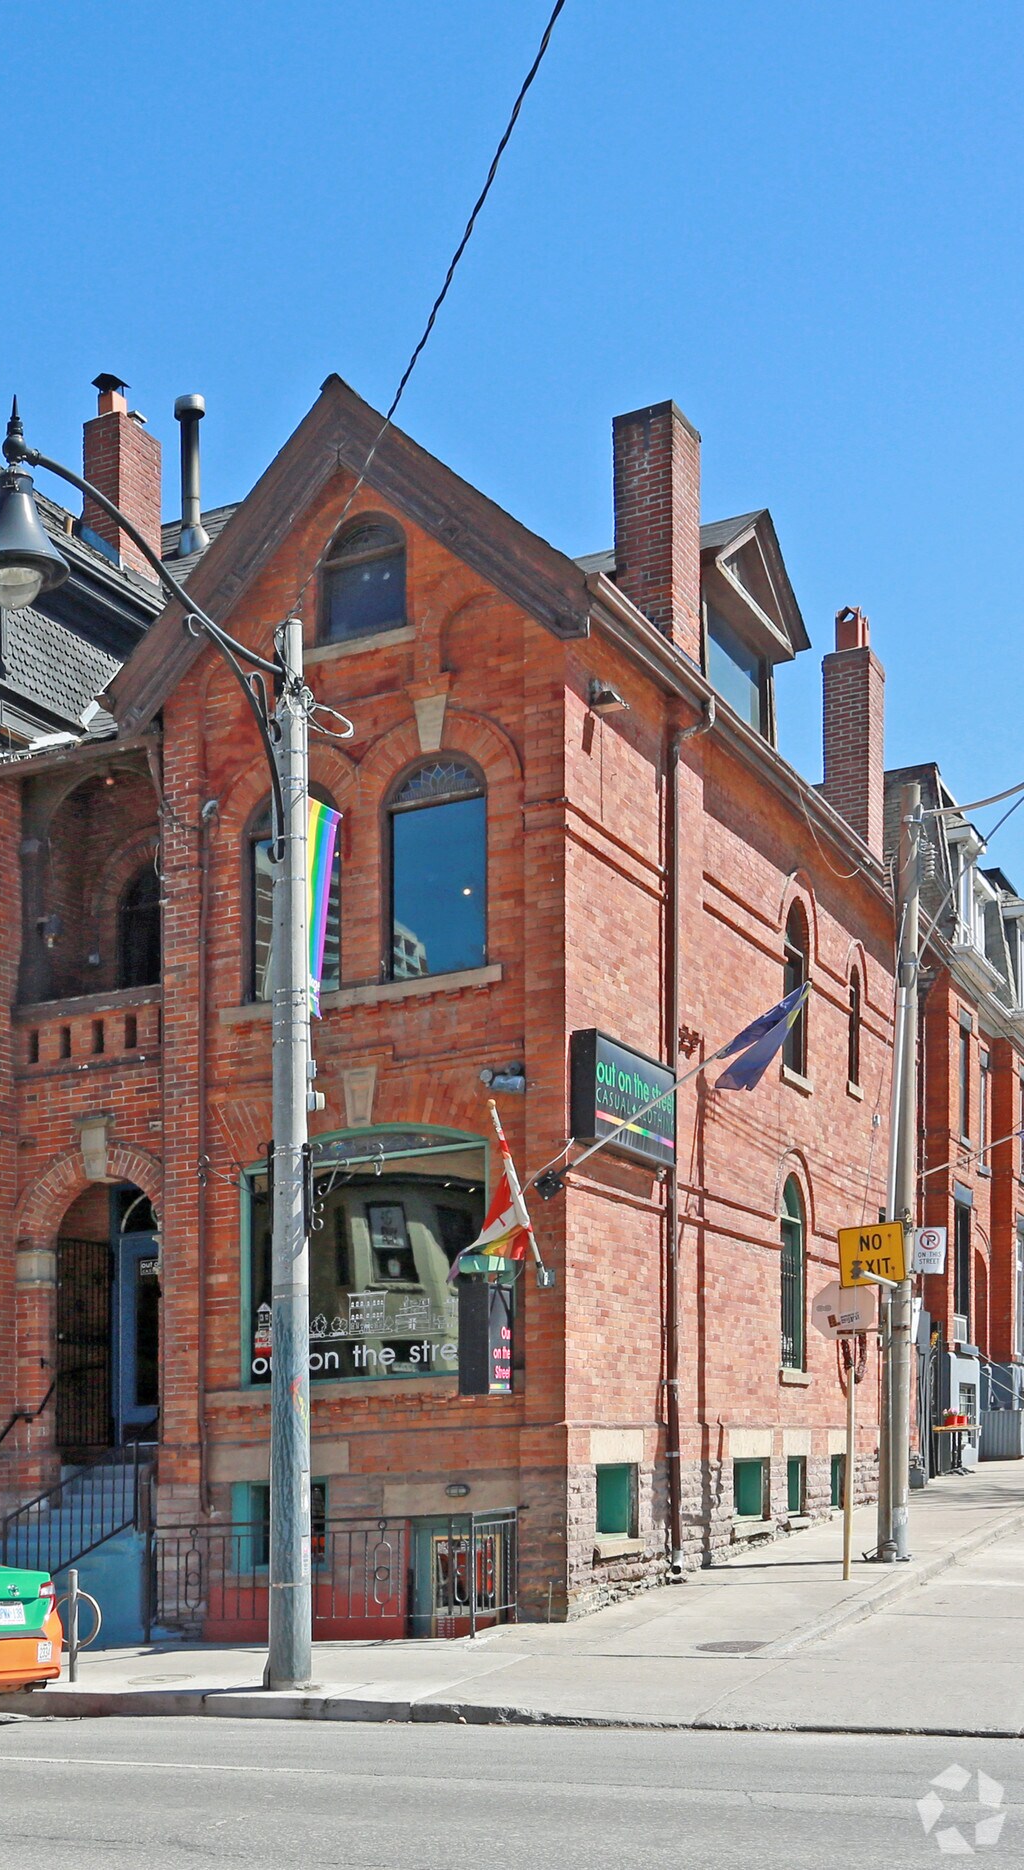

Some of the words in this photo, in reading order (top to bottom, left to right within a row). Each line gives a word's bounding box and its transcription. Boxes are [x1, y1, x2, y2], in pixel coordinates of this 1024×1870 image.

[597, 1062, 616, 1087] out
[619, 1071, 631, 1095] on
[634, 1073, 649, 1103] the
[596, 1087, 631, 1115] CASUAL
[859, 1233, 882, 1252] NO
[352, 1345, 396, 1368] the
[409, 1340, 458, 1363] stre
[493, 1348, 501, 1359] on
